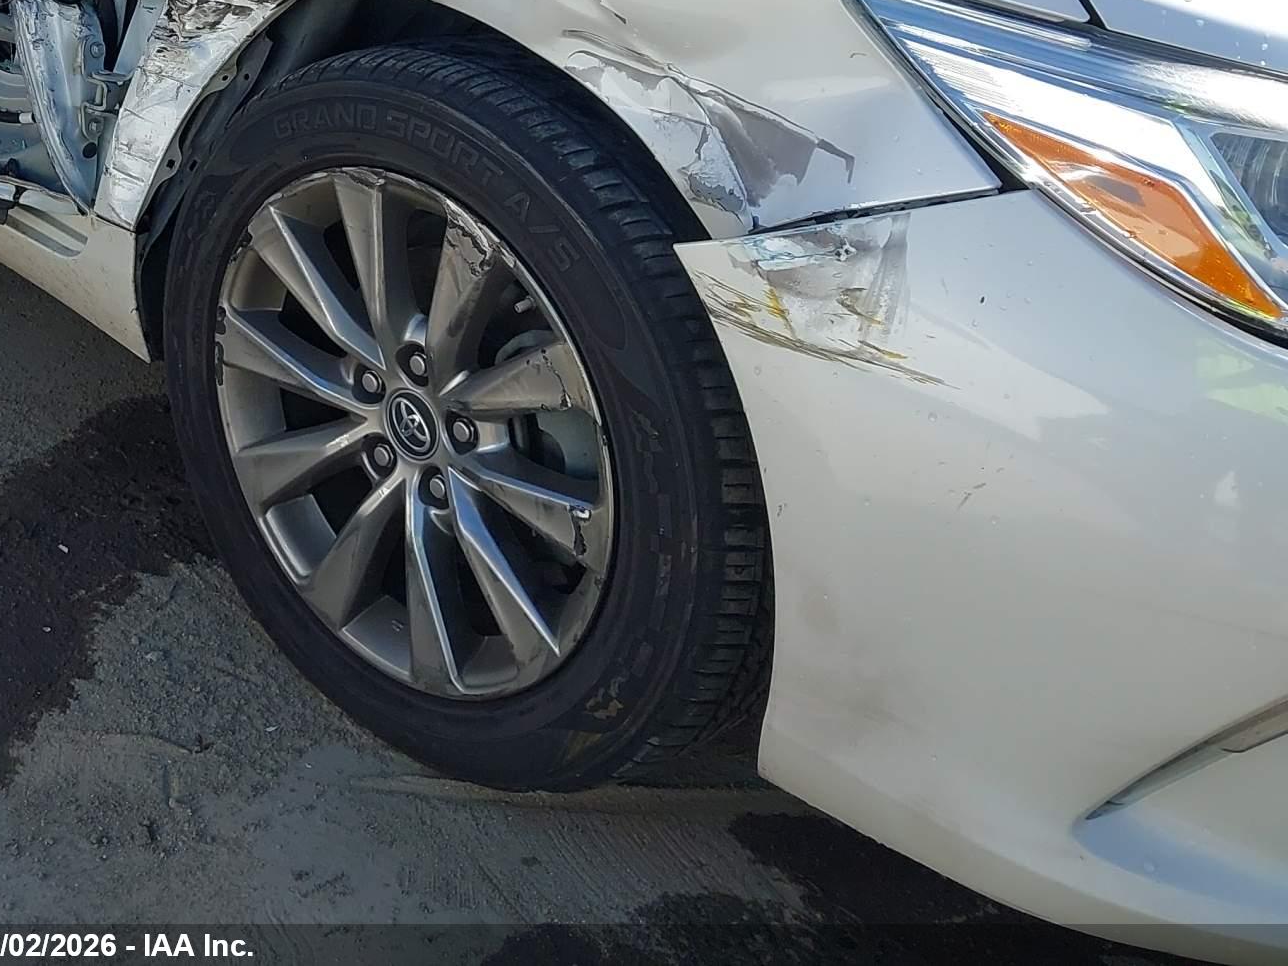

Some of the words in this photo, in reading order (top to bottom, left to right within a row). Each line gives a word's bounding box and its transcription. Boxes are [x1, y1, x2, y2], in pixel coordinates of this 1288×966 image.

[272, 103, 377, 139] GRAND
[386, 110, 504, 182] SPORT
[503, 191, 581, 273] A/S
